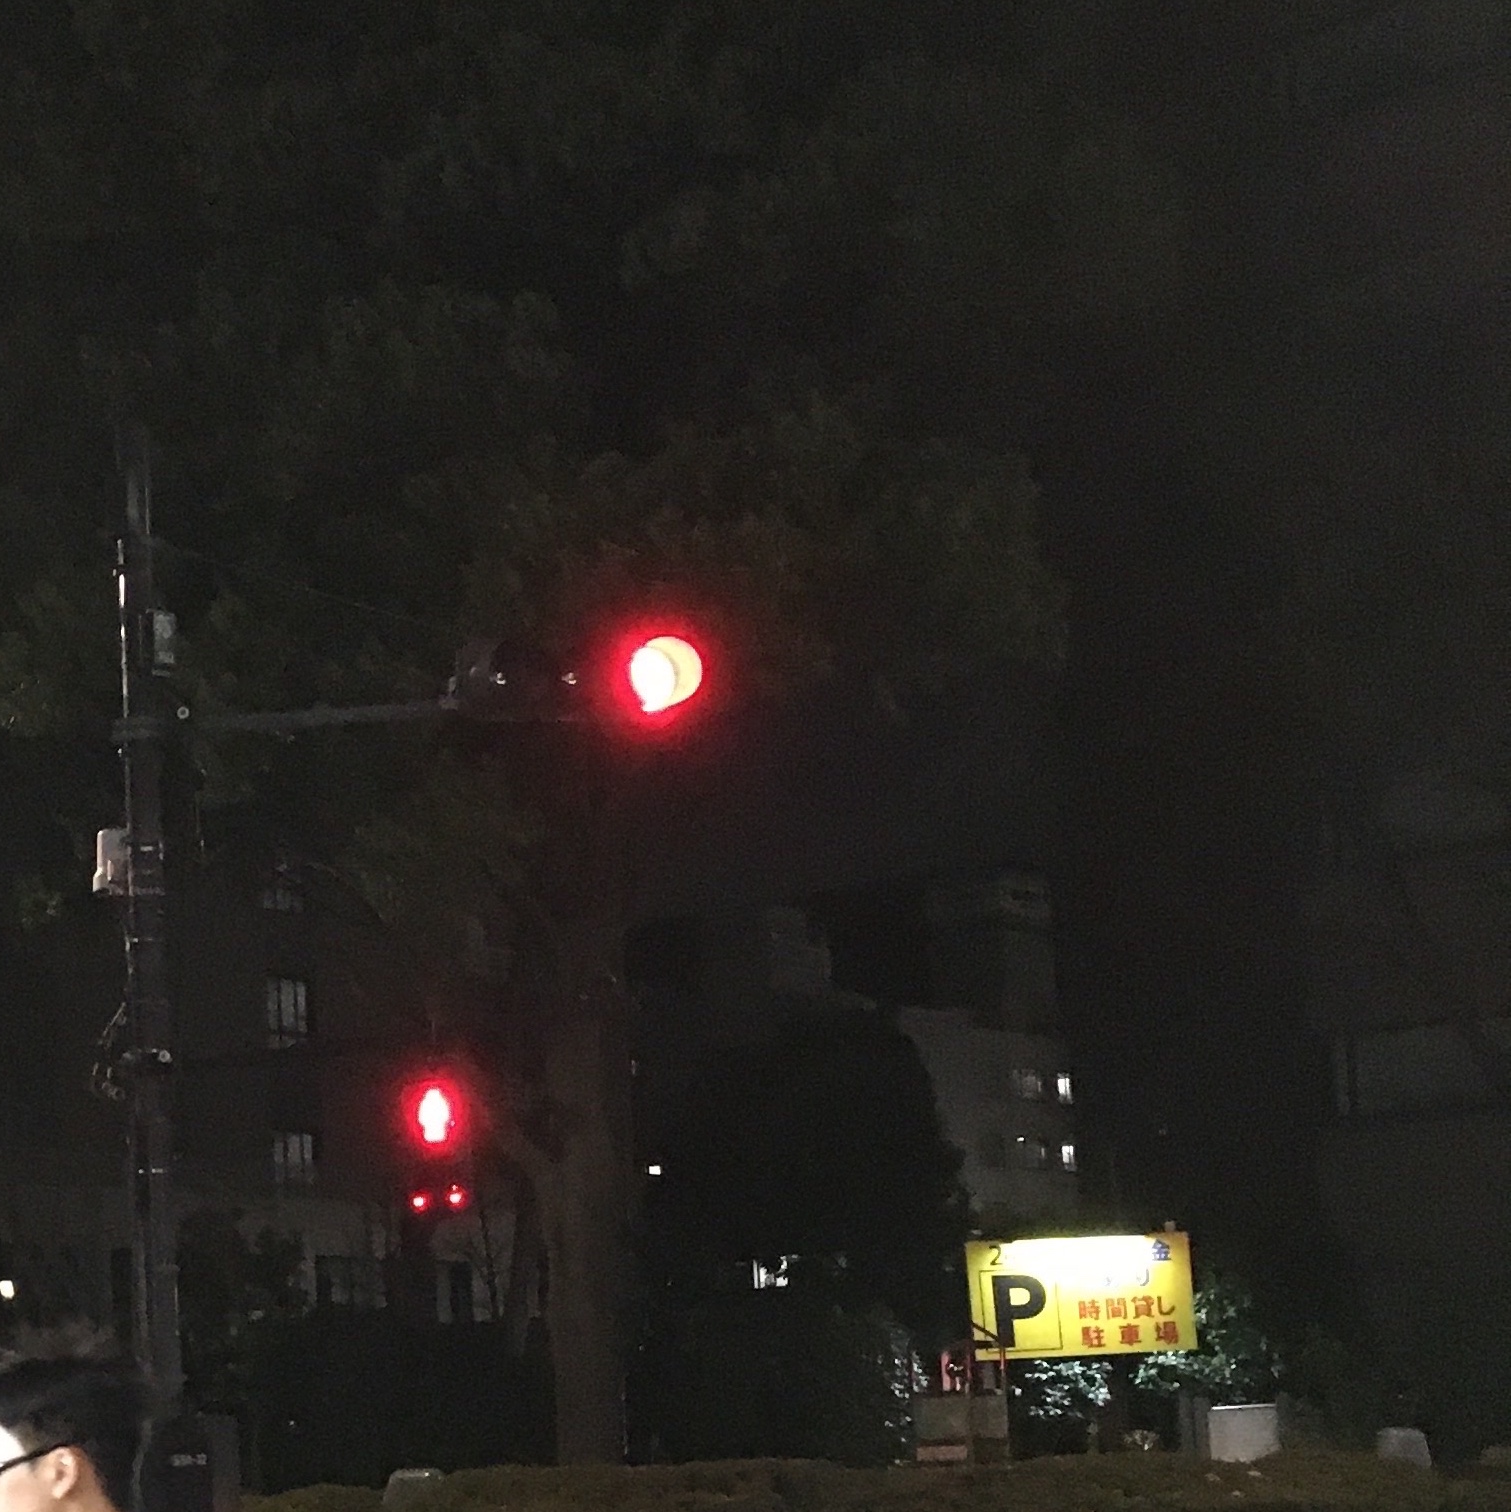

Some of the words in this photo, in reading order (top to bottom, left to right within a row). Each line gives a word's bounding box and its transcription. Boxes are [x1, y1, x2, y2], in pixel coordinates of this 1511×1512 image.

[991, 1274, 1047, 1348] P
[1077, 1294, 1176, 1321] 時間貸し
[1080, 1321, 1180, 1349] 駐車場
